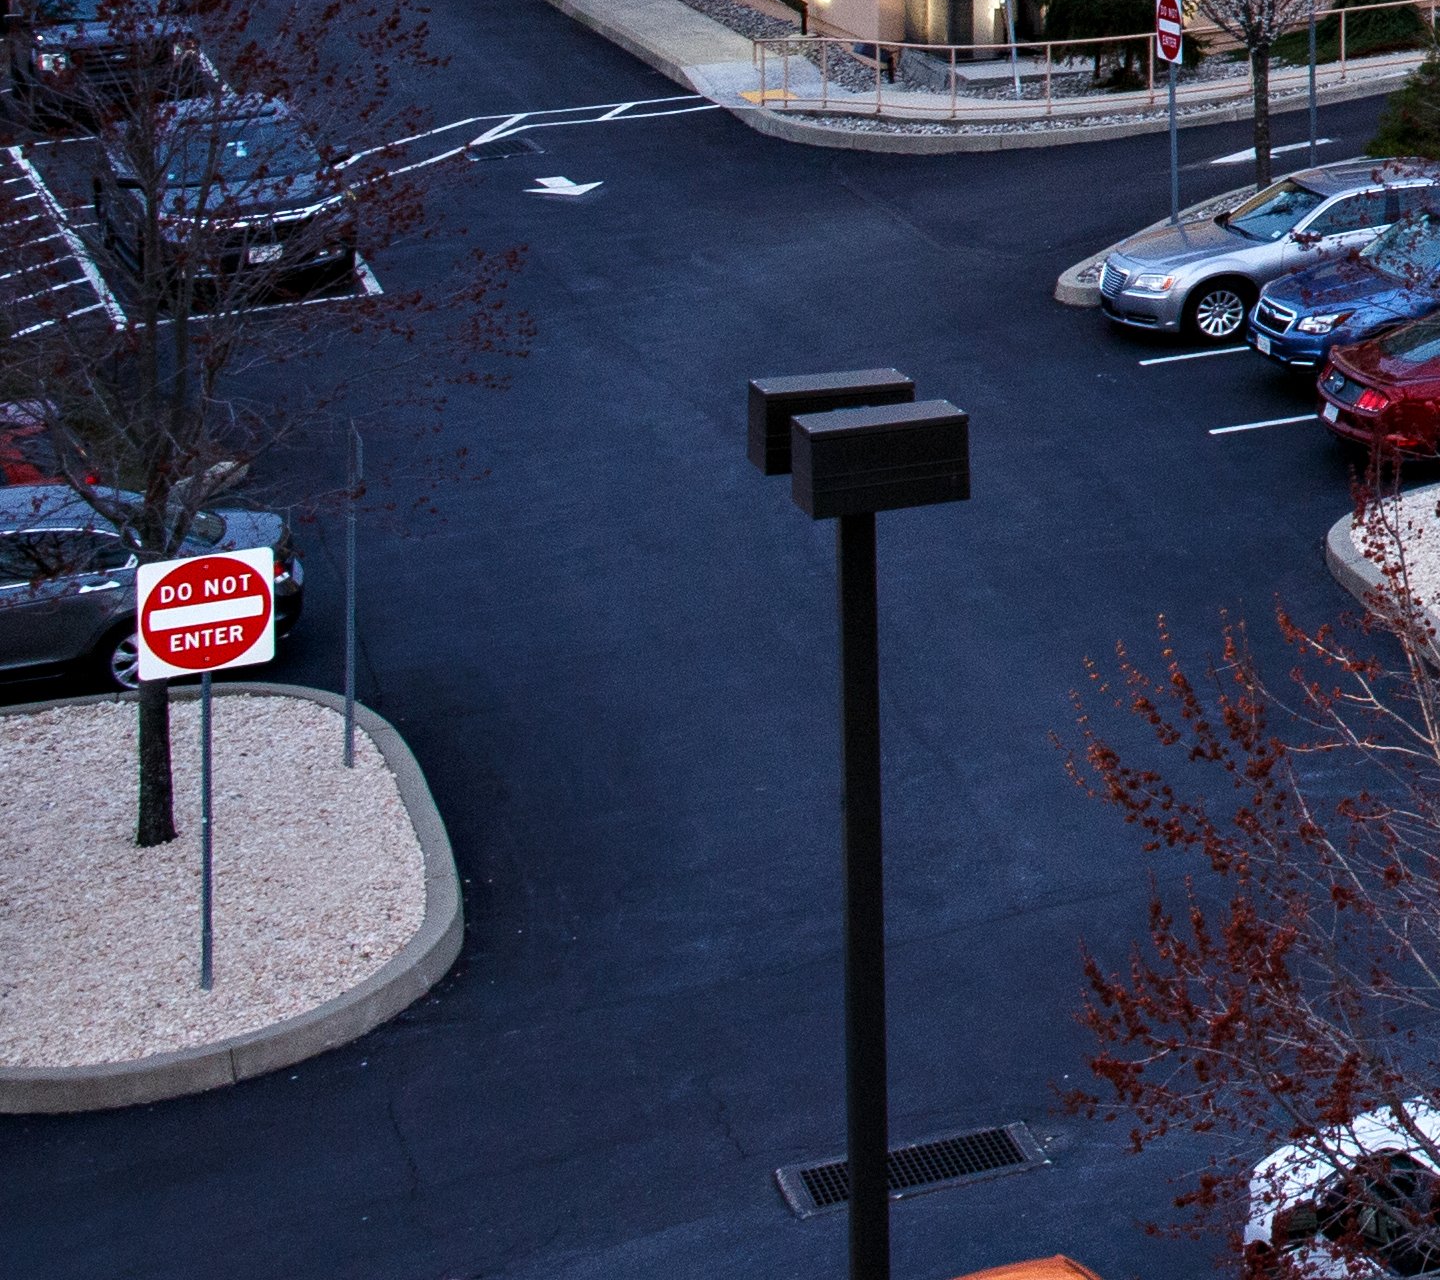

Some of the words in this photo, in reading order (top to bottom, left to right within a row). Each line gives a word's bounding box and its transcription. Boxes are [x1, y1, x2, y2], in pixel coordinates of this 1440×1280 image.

[1160, 5, 1167, 16] DO
[160, 582, 193, 604] DO
[204, 573, 252, 598] NOT
[170, 625, 244, 653] ENTER
